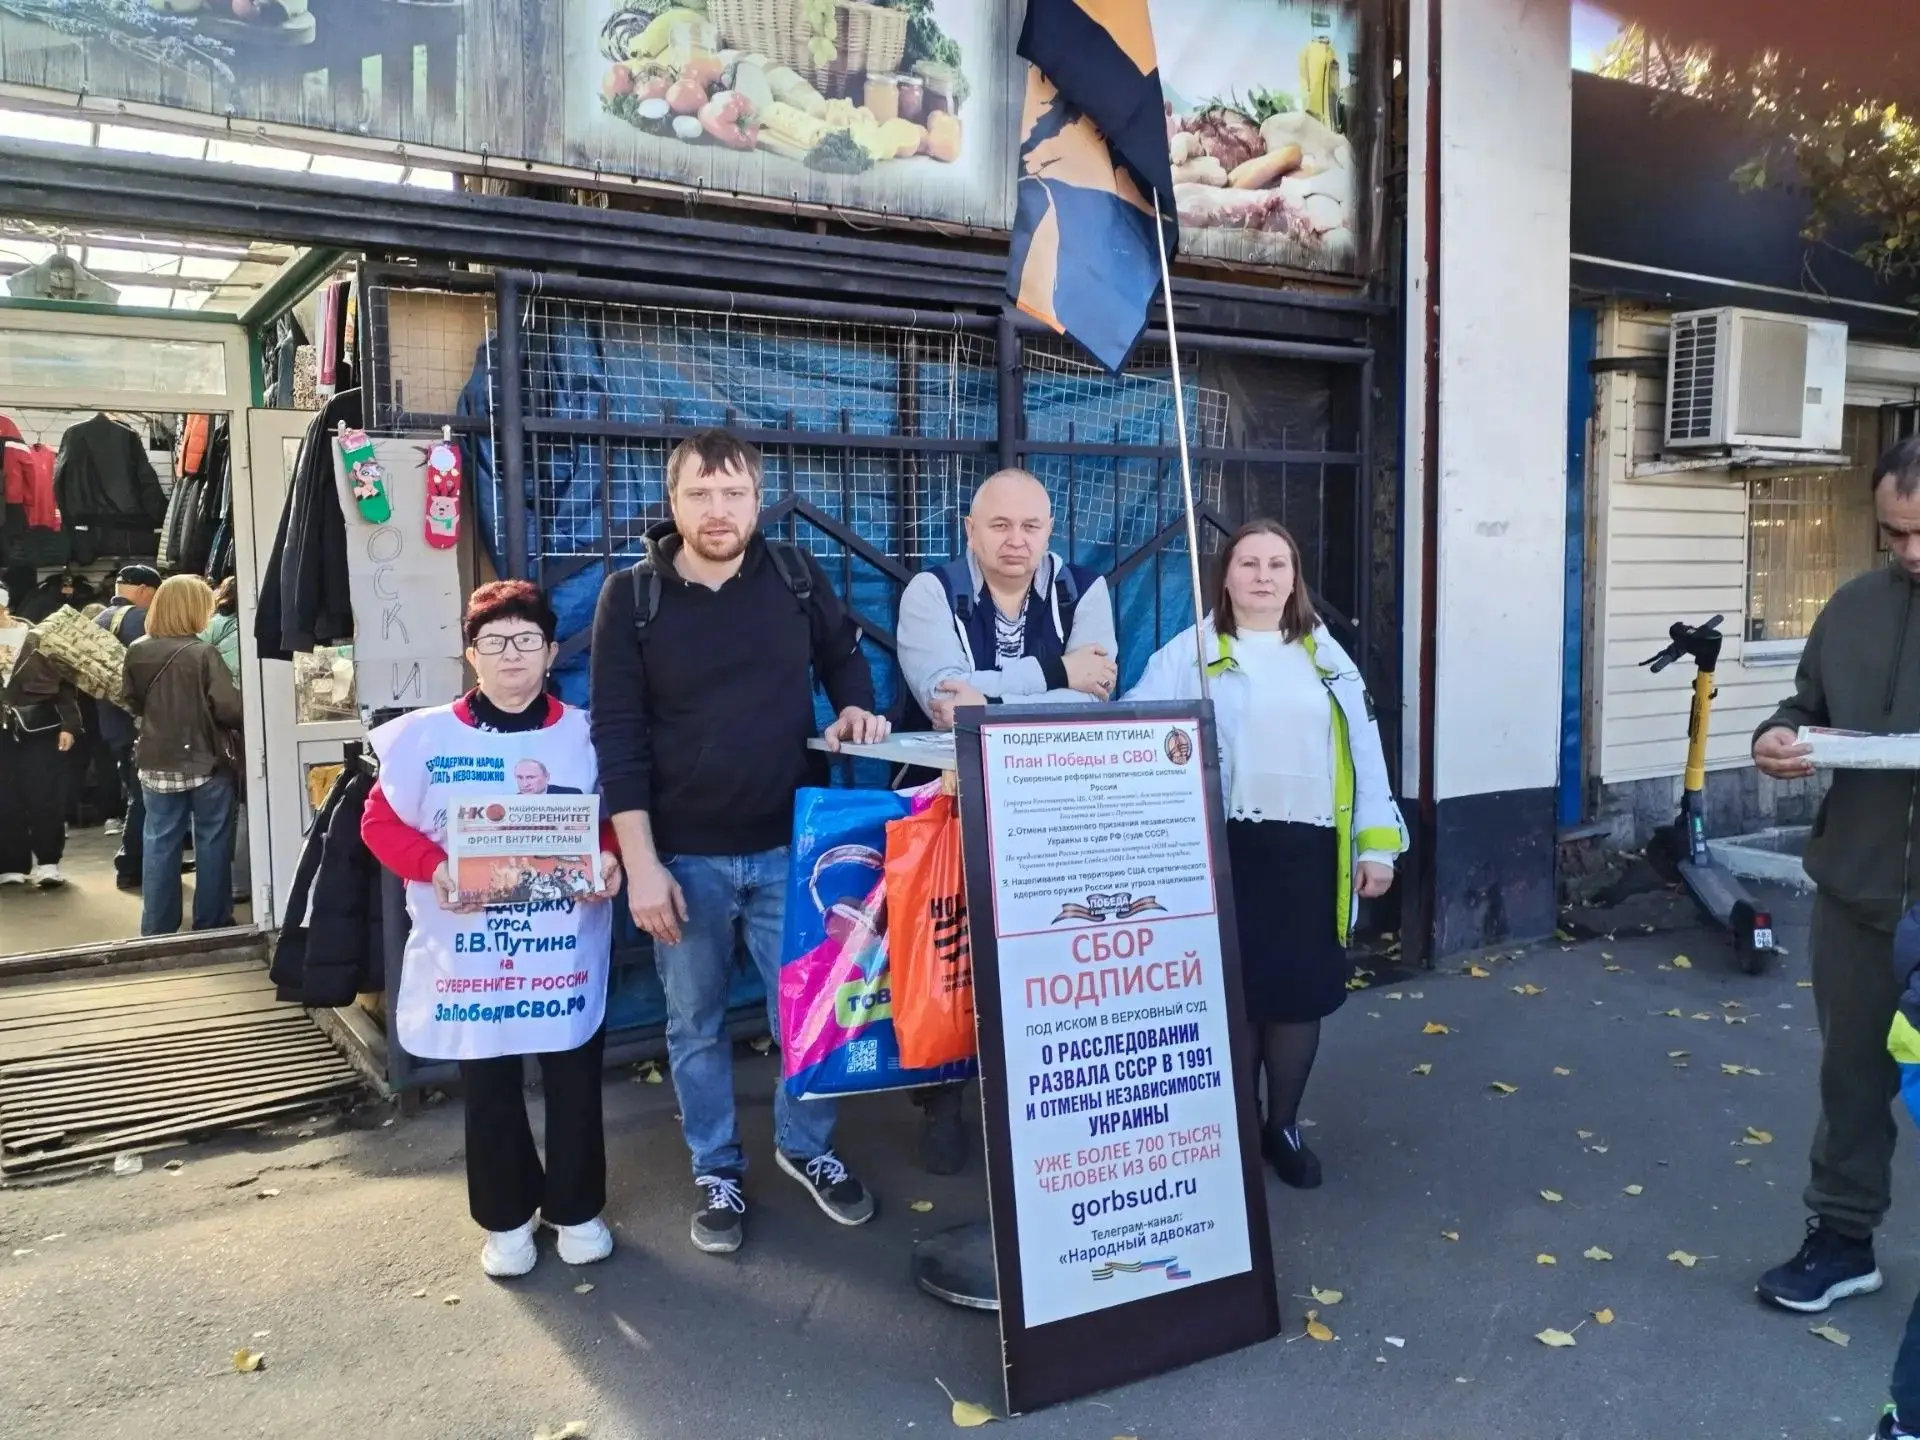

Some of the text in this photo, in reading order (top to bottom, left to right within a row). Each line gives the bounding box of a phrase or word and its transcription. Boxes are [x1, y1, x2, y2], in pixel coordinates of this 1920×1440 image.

[1003, 728, 1154, 746] ПОДДЕРЖИВАЕМ ПУТИНА!
[476, 757, 504, 769] НАРОДА
[1004, 748, 1157, 769] План Победы в СВО!
[453, 770, 504, 782] НЕВОЗМОЖНО
[1013, 775, 1063, 784] Суверенные
[1064, 772, 1101, 781] реформы
[1103, 768, 1154, 779] политической
[1156, 768, 1187, 776] системы
[1090, 783, 1118, 792] России
[508, 813, 590, 822] СУВЕРЕНИТЕТ
[1016, 826, 1047, 835] Отмена
[1048, 823, 1097, 833] незаконного
[1098, 820, 1139, 830] признания
[1140, 816, 1196, 826] независимости
[467, 835, 582, 845] ФРОНТ ВНУТРИ СТРАНЫ
[1047, 836, 1082, 846] Украины
[1090, 835, 1108, 844] суде
[1109, 832, 1121, 840] РФ
[1011, 875, 1065, 885] Нацеливание
[1078, 871, 1125, 880] территорию
[1127, 866, 1146, 876] США
[1147, 862, 1207, 874] стратегического
[1013, 889, 1052, 899] ядерного
[1053, 886, 1083, 896] оружия
[1084, 883, 1113, 892] России
[1131, 879, 1155, 890] угроза
[1089, 896, 1129, 908] ПОБЕДА
[487, 918, 532, 932] КУРСА
[455, 932, 576, 957] В.В. Путина
[1072, 928, 1154, 964] СБОР
[435, 970, 589, 993] СУВЕРЕНИТЕТ РОССИИ
[1025, 951, 1202, 1009] ПОДПИСЕЙ
[1026, 1000, 1208, 1037] ПОД ИСКОМ В ВЕРХОВНЫЙ СУД
[1042, 1022, 1199, 1066] О РАССЛЕДОВАНИИ
[1029, 1046, 1213, 1096] РАЗВАЛА СССР В 1991
[1026, 1071, 1221, 1121] И ОТМЕНЫ НЕЗАВИСИМОСТИ
[1089, 1103, 1169, 1137] УКРАИНЫ
[1035, 1123, 1222, 1175] УЖЕ БОЛЕЕ 700 ТЫСЯЧ
[1039, 1143, 1220, 1194] ЧЕЛОВЕК ИЗ 60 СТРАН
[1071, 1177, 1197, 1225] gorbsud.ru
[1091, 1212, 1183, 1242] Телеграм-канал:
[1059, 1219, 1215, 1265] «Народный адвокат»
